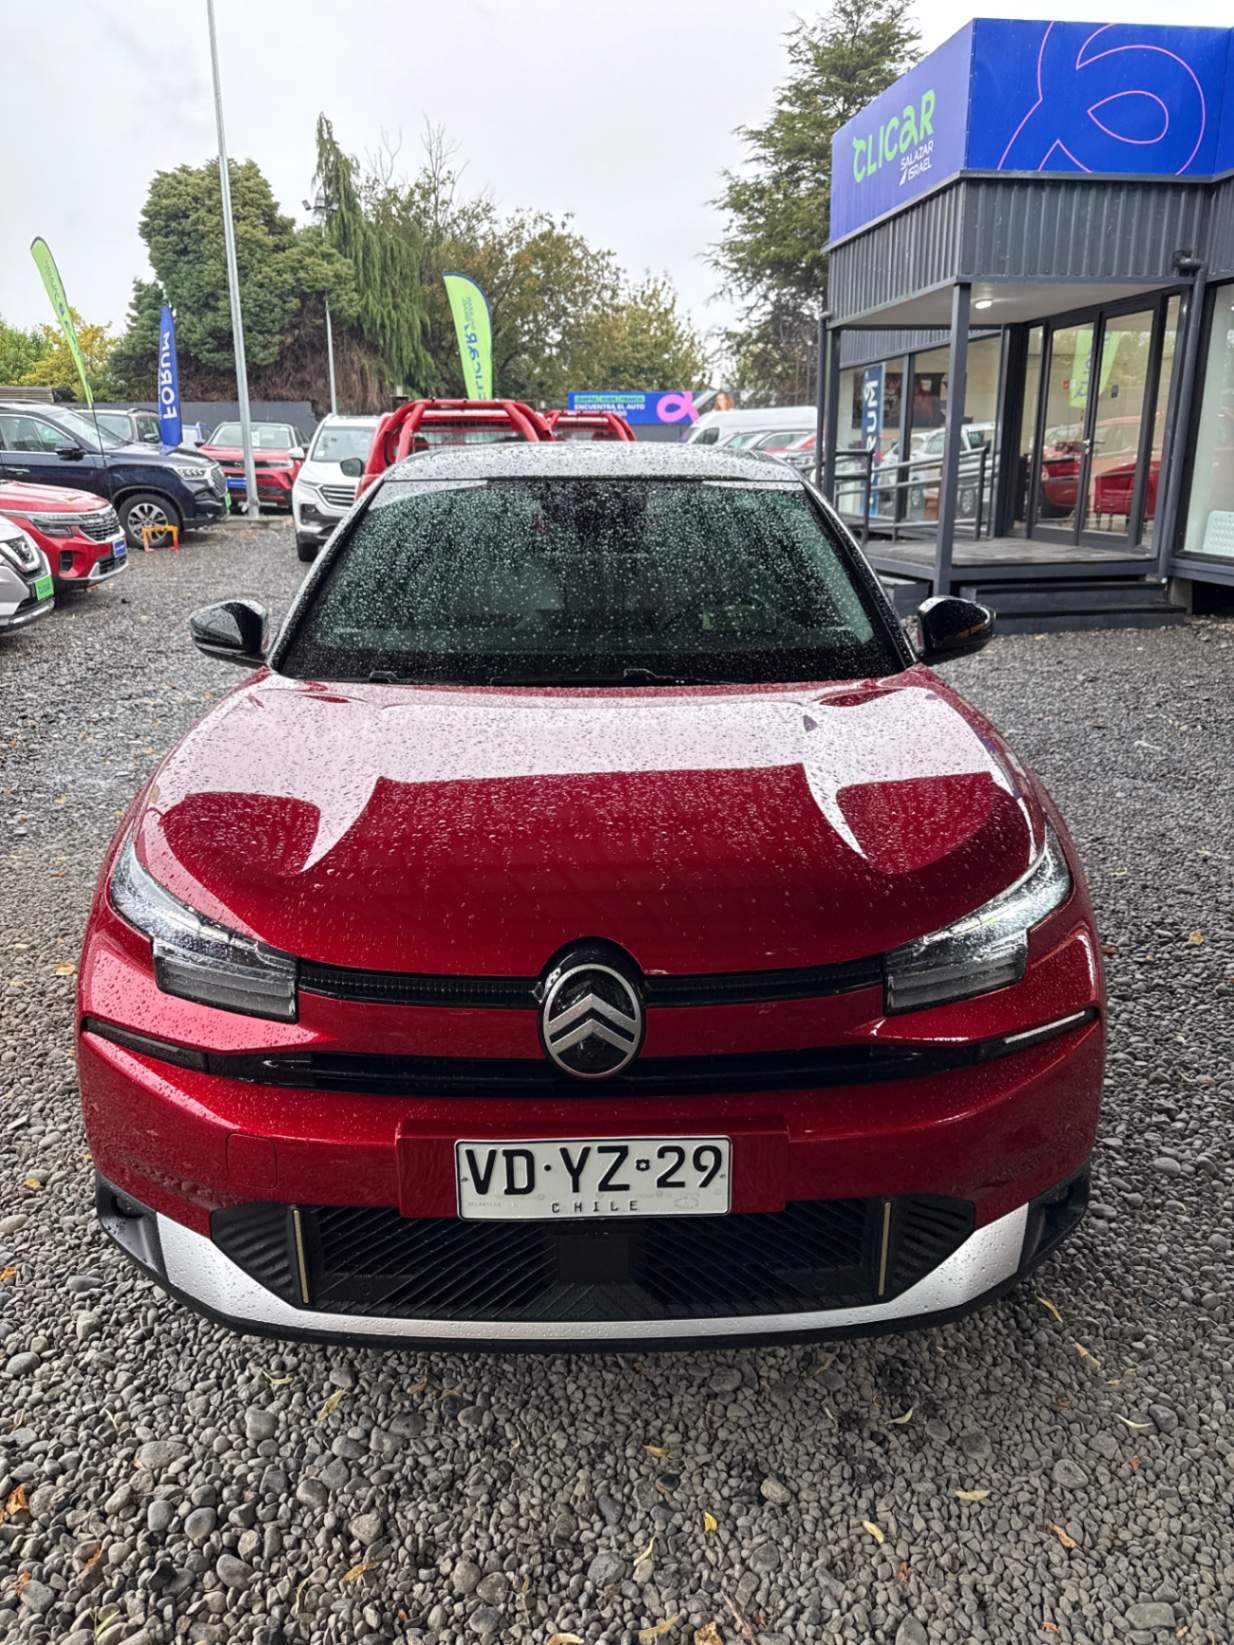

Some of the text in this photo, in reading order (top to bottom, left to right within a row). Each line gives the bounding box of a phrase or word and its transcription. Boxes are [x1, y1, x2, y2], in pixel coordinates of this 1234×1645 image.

[901, 140, 934, 170] SALAZAR
[906, 157, 932, 182] ISRAEL
[551, 1199, 638, 1213] CHILE
